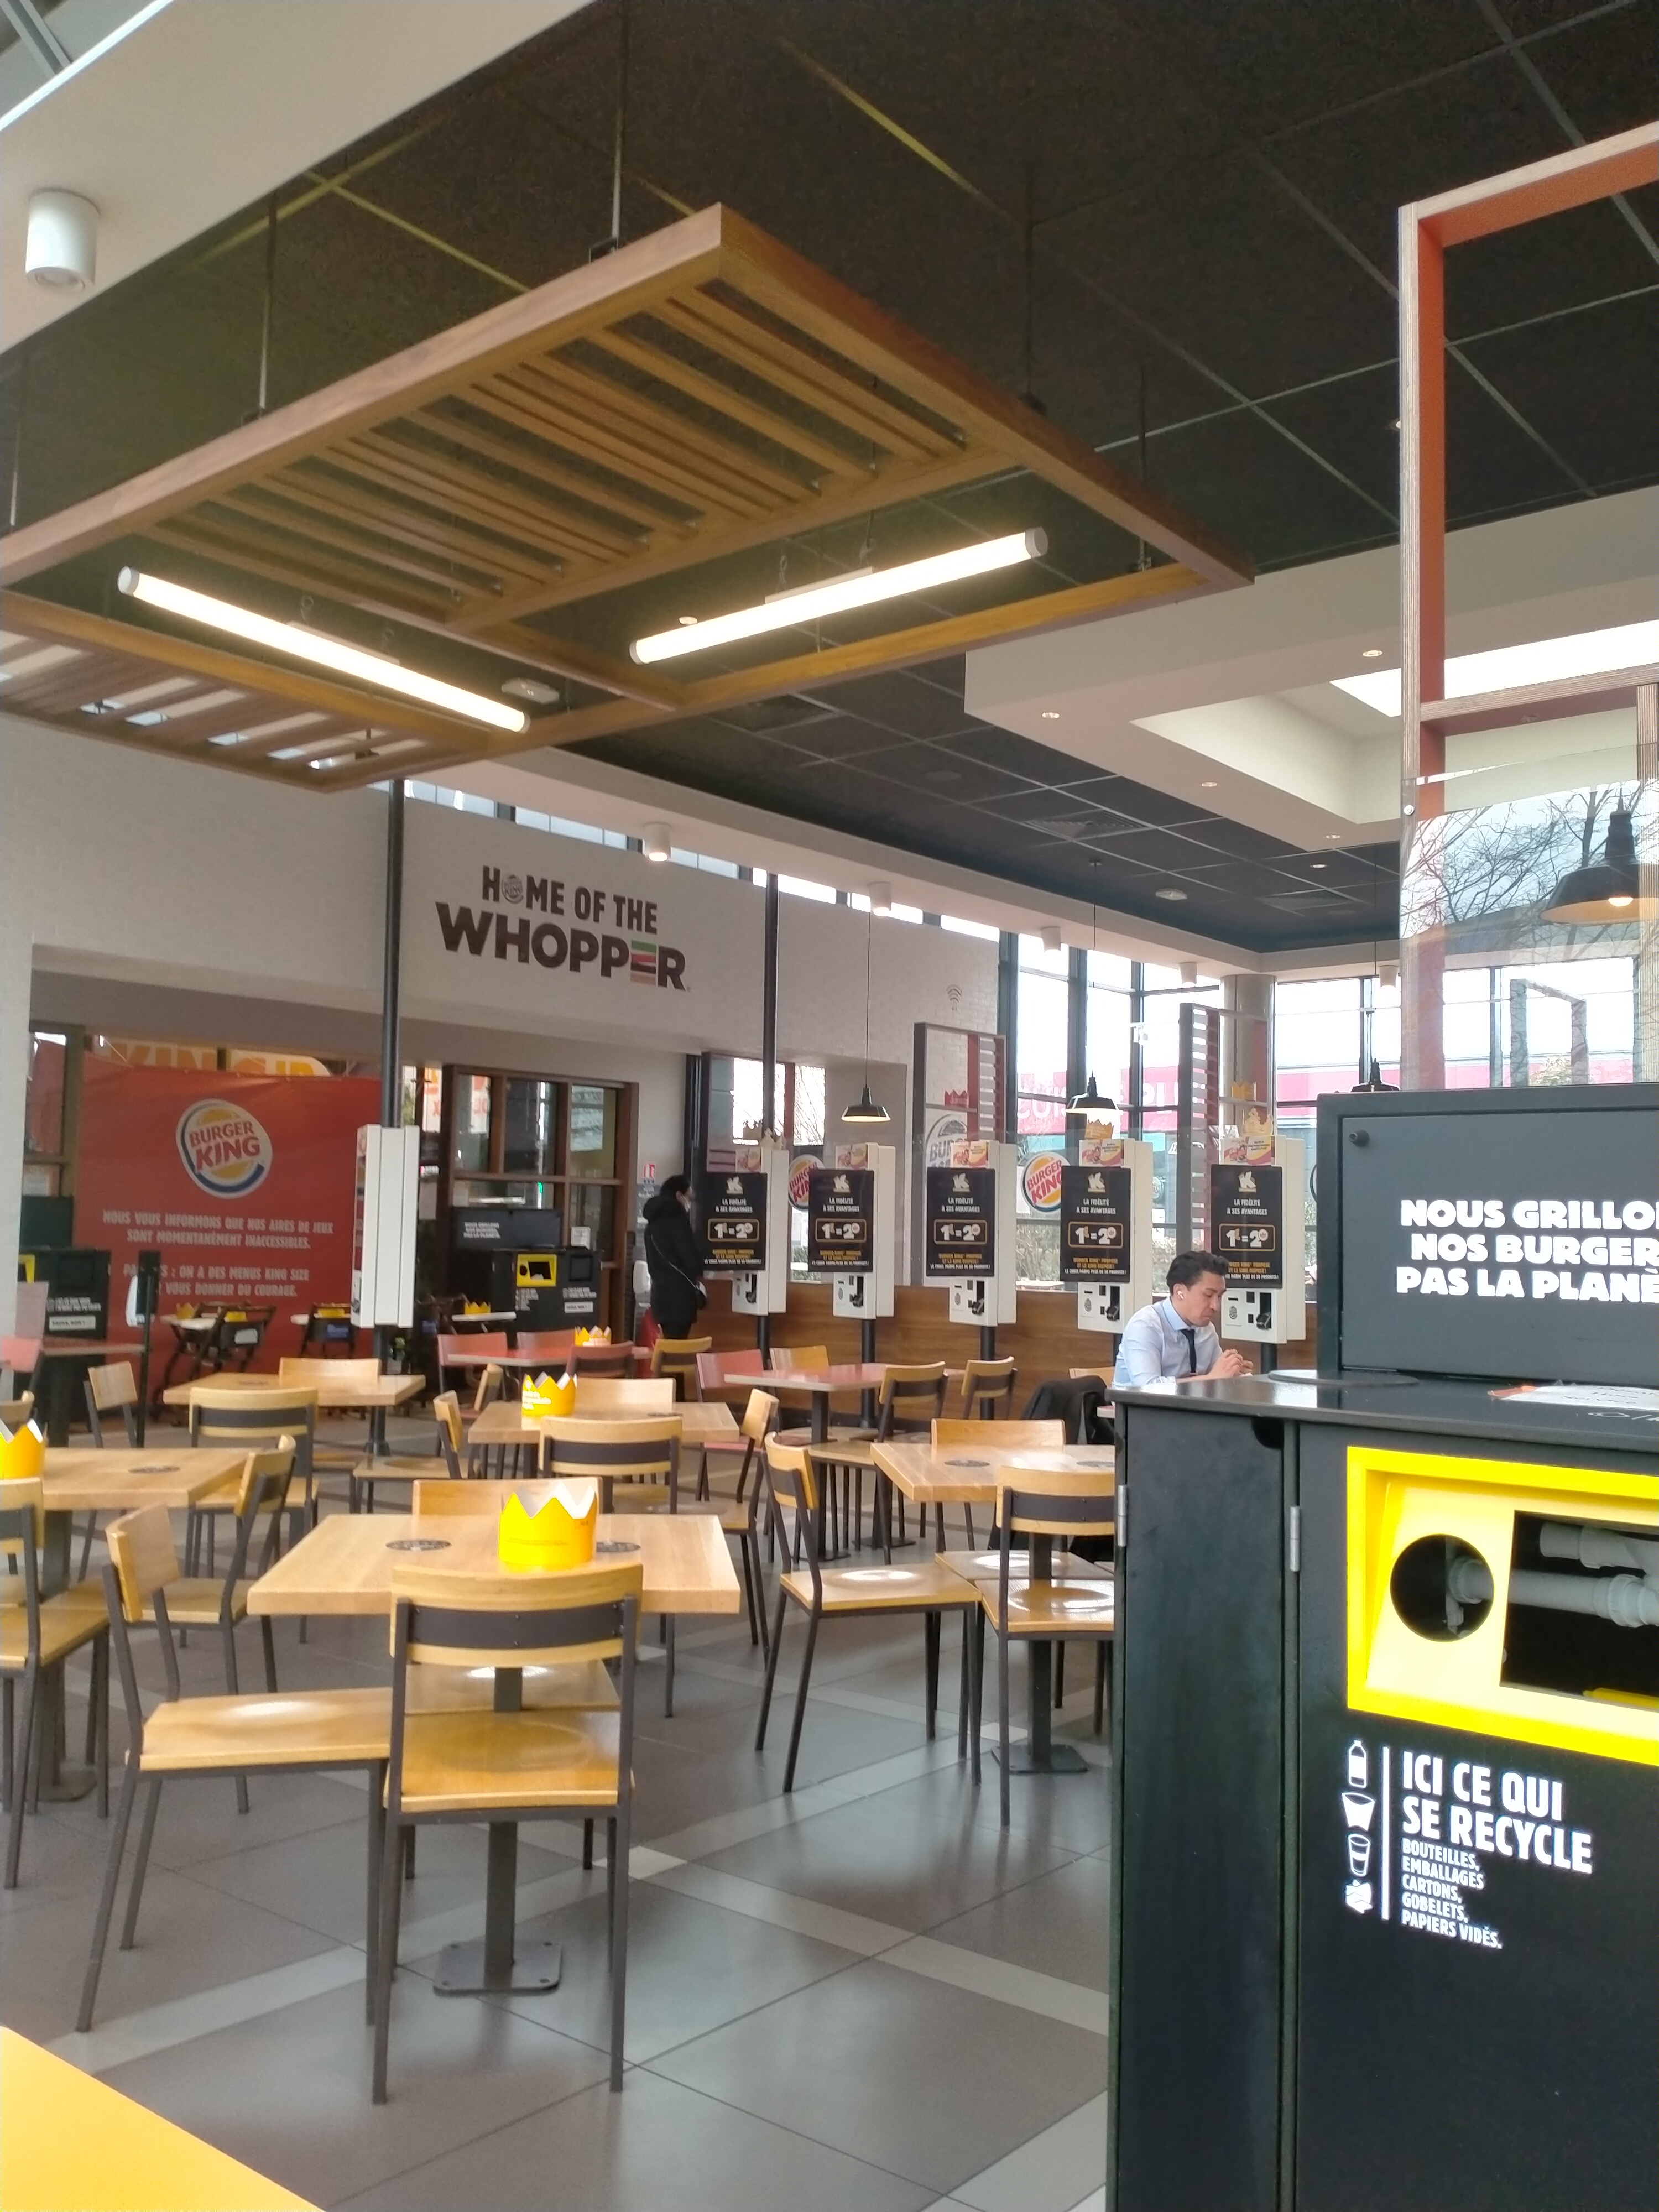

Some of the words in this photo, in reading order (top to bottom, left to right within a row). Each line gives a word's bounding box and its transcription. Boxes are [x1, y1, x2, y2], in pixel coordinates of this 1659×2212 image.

[575, 886, 606, 923] OF
[613, 894, 658, 935] THE
[435, 901, 686, 991] WHOPPER
[189, 1119, 255, 1147] BURGER
[196, 1136, 260, 1171] KING
[1027, 1159, 1062, 1190] BURGER
[103, 1210, 131, 1225] NOUS
[134, 1212, 161, 1226] VOUS
[165, 1213, 221, 1229] INFORMONS
[225, 1216, 244, 1230] QUE
[247, 1218, 266, 1232] NOS
[269, 1219, 295, 1233] AIRES
[298, 1220, 310, 1233] DE
[312, 1222, 333, 1234] JEUX
[1090, 1207, 1116, 1215] AVANTAGES
[1401, 1199, 1505, 1228] NOUS
[1512, 1200, 1659, 1230] GRILLO
[126, 1228, 154, 1244] SONT
[156, 1229, 242, 1246] MOMENTANÉMENT
[714, 1223, 724, 1238] 1
[735, 1223, 747, 1239] 2
[822, 1223, 831, 1239] 1
[843, 1223, 855, 1239] 2
[940, 1224, 950, 1241] 1
[963, 1224, 975, 1241] 2
[1075, 1227, 1085, 1244] 1
[1098, 1227, 1110, 1245] 2
[1226, 1229, 1236, 1247] 1
[1249, 1230, 1262, 1248] 2
[1411, 1233, 1488, 1262] NOS
[179, 1265, 194, 1279] ON
[197, 1265, 205, 1279] A
[208, 1266, 226, 1280] DES
[229, 1266, 262, 1281] MENUS
[265, 1267, 287, 1281] KING
[290, 1268, 310, 1281] SIZE
[1396, 1266, 1469, 1296] PAS
[1477, 1269, 1525, 1298] LA
[165, 1282, 191, 1295] VOUS
[195, 1282, 234, 1296] DONNER
[237, 1283, 252, 1297] DU
[1402, 1750, 1443, 1796] ICI
[1453, 1762, 1492, 1807] CE
[1501, 1771, 1563, 1822] QUI
[1402, 1795, 1441, 1840] SE
[1451, 1804, 1593, 1875] RECYCLE
[1402, 1855, 1485, 1890] EMBALLAGES
[1401, 1908, 1457, 1938] PAPIERS
